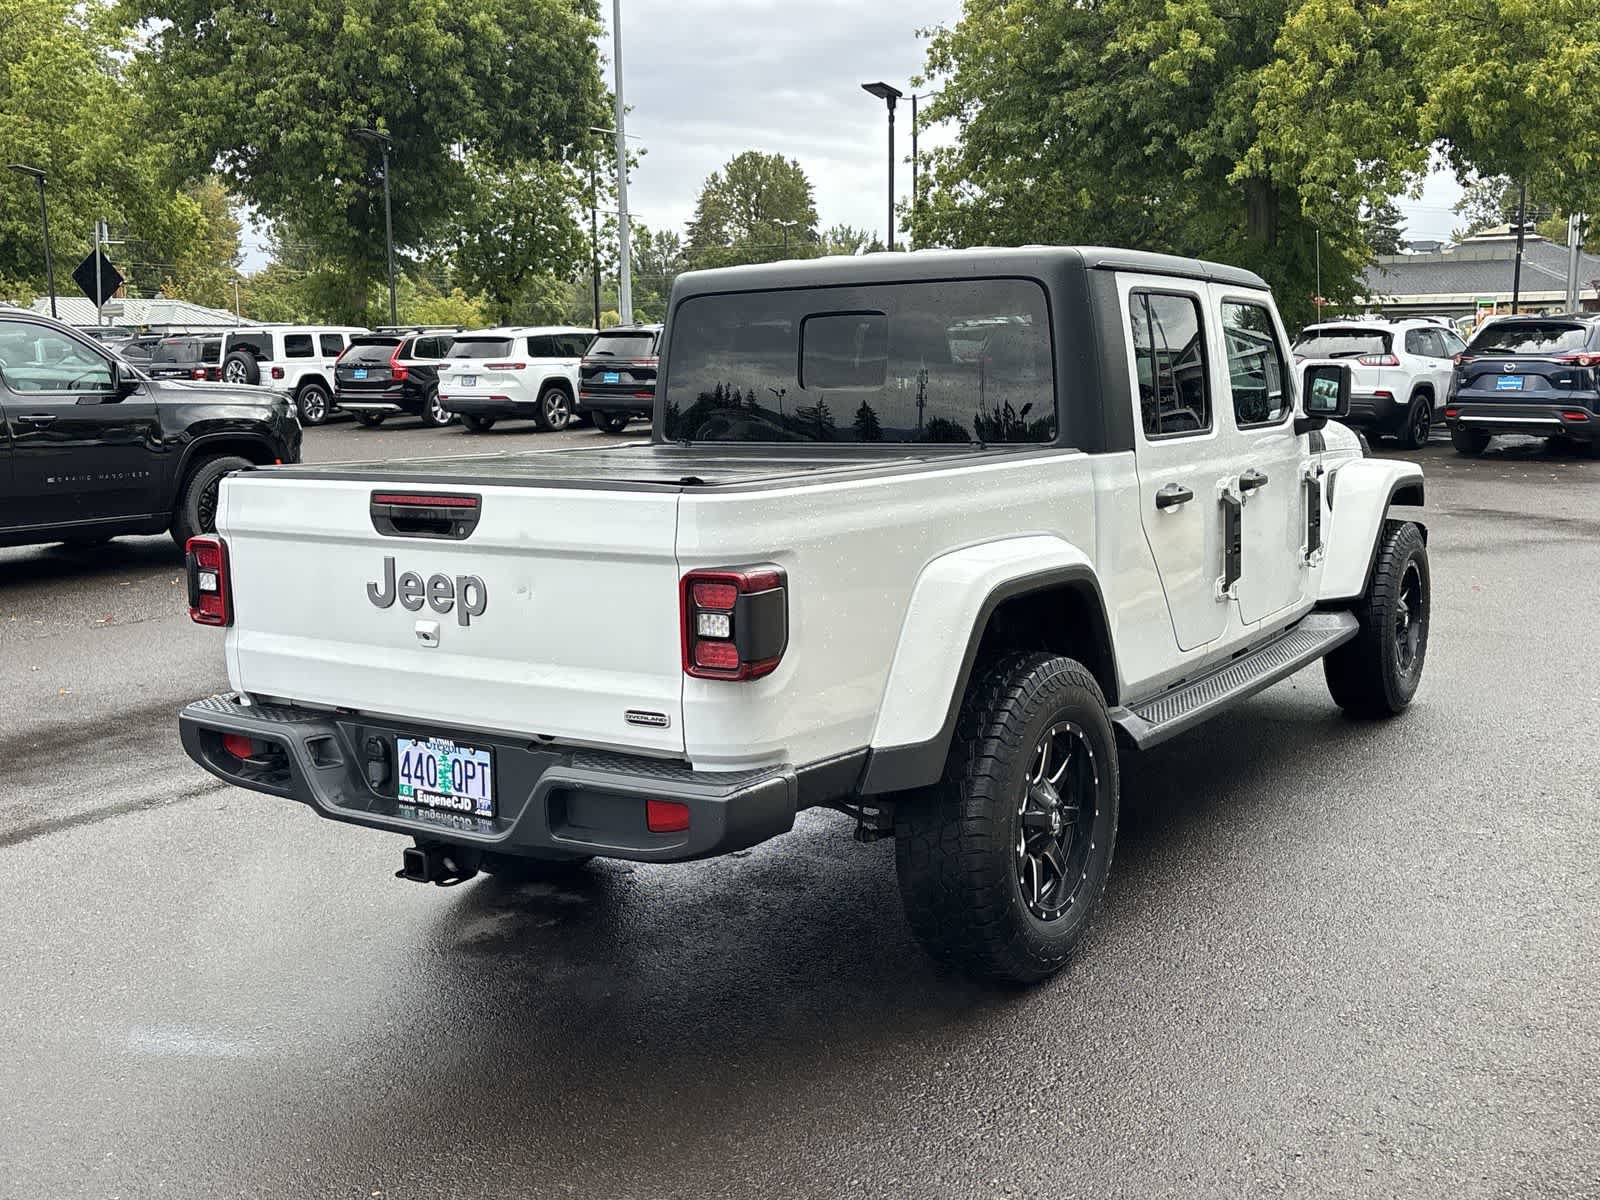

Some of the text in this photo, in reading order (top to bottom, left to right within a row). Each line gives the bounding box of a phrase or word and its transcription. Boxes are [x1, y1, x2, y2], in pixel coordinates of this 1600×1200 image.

[366, 556, 488, 627] Jeep
[625, 714, 668, 723] OVERLAND
[401, 750, 489, 797] 440 QPT
[416, 789, 472, 811] EugeneCJD
